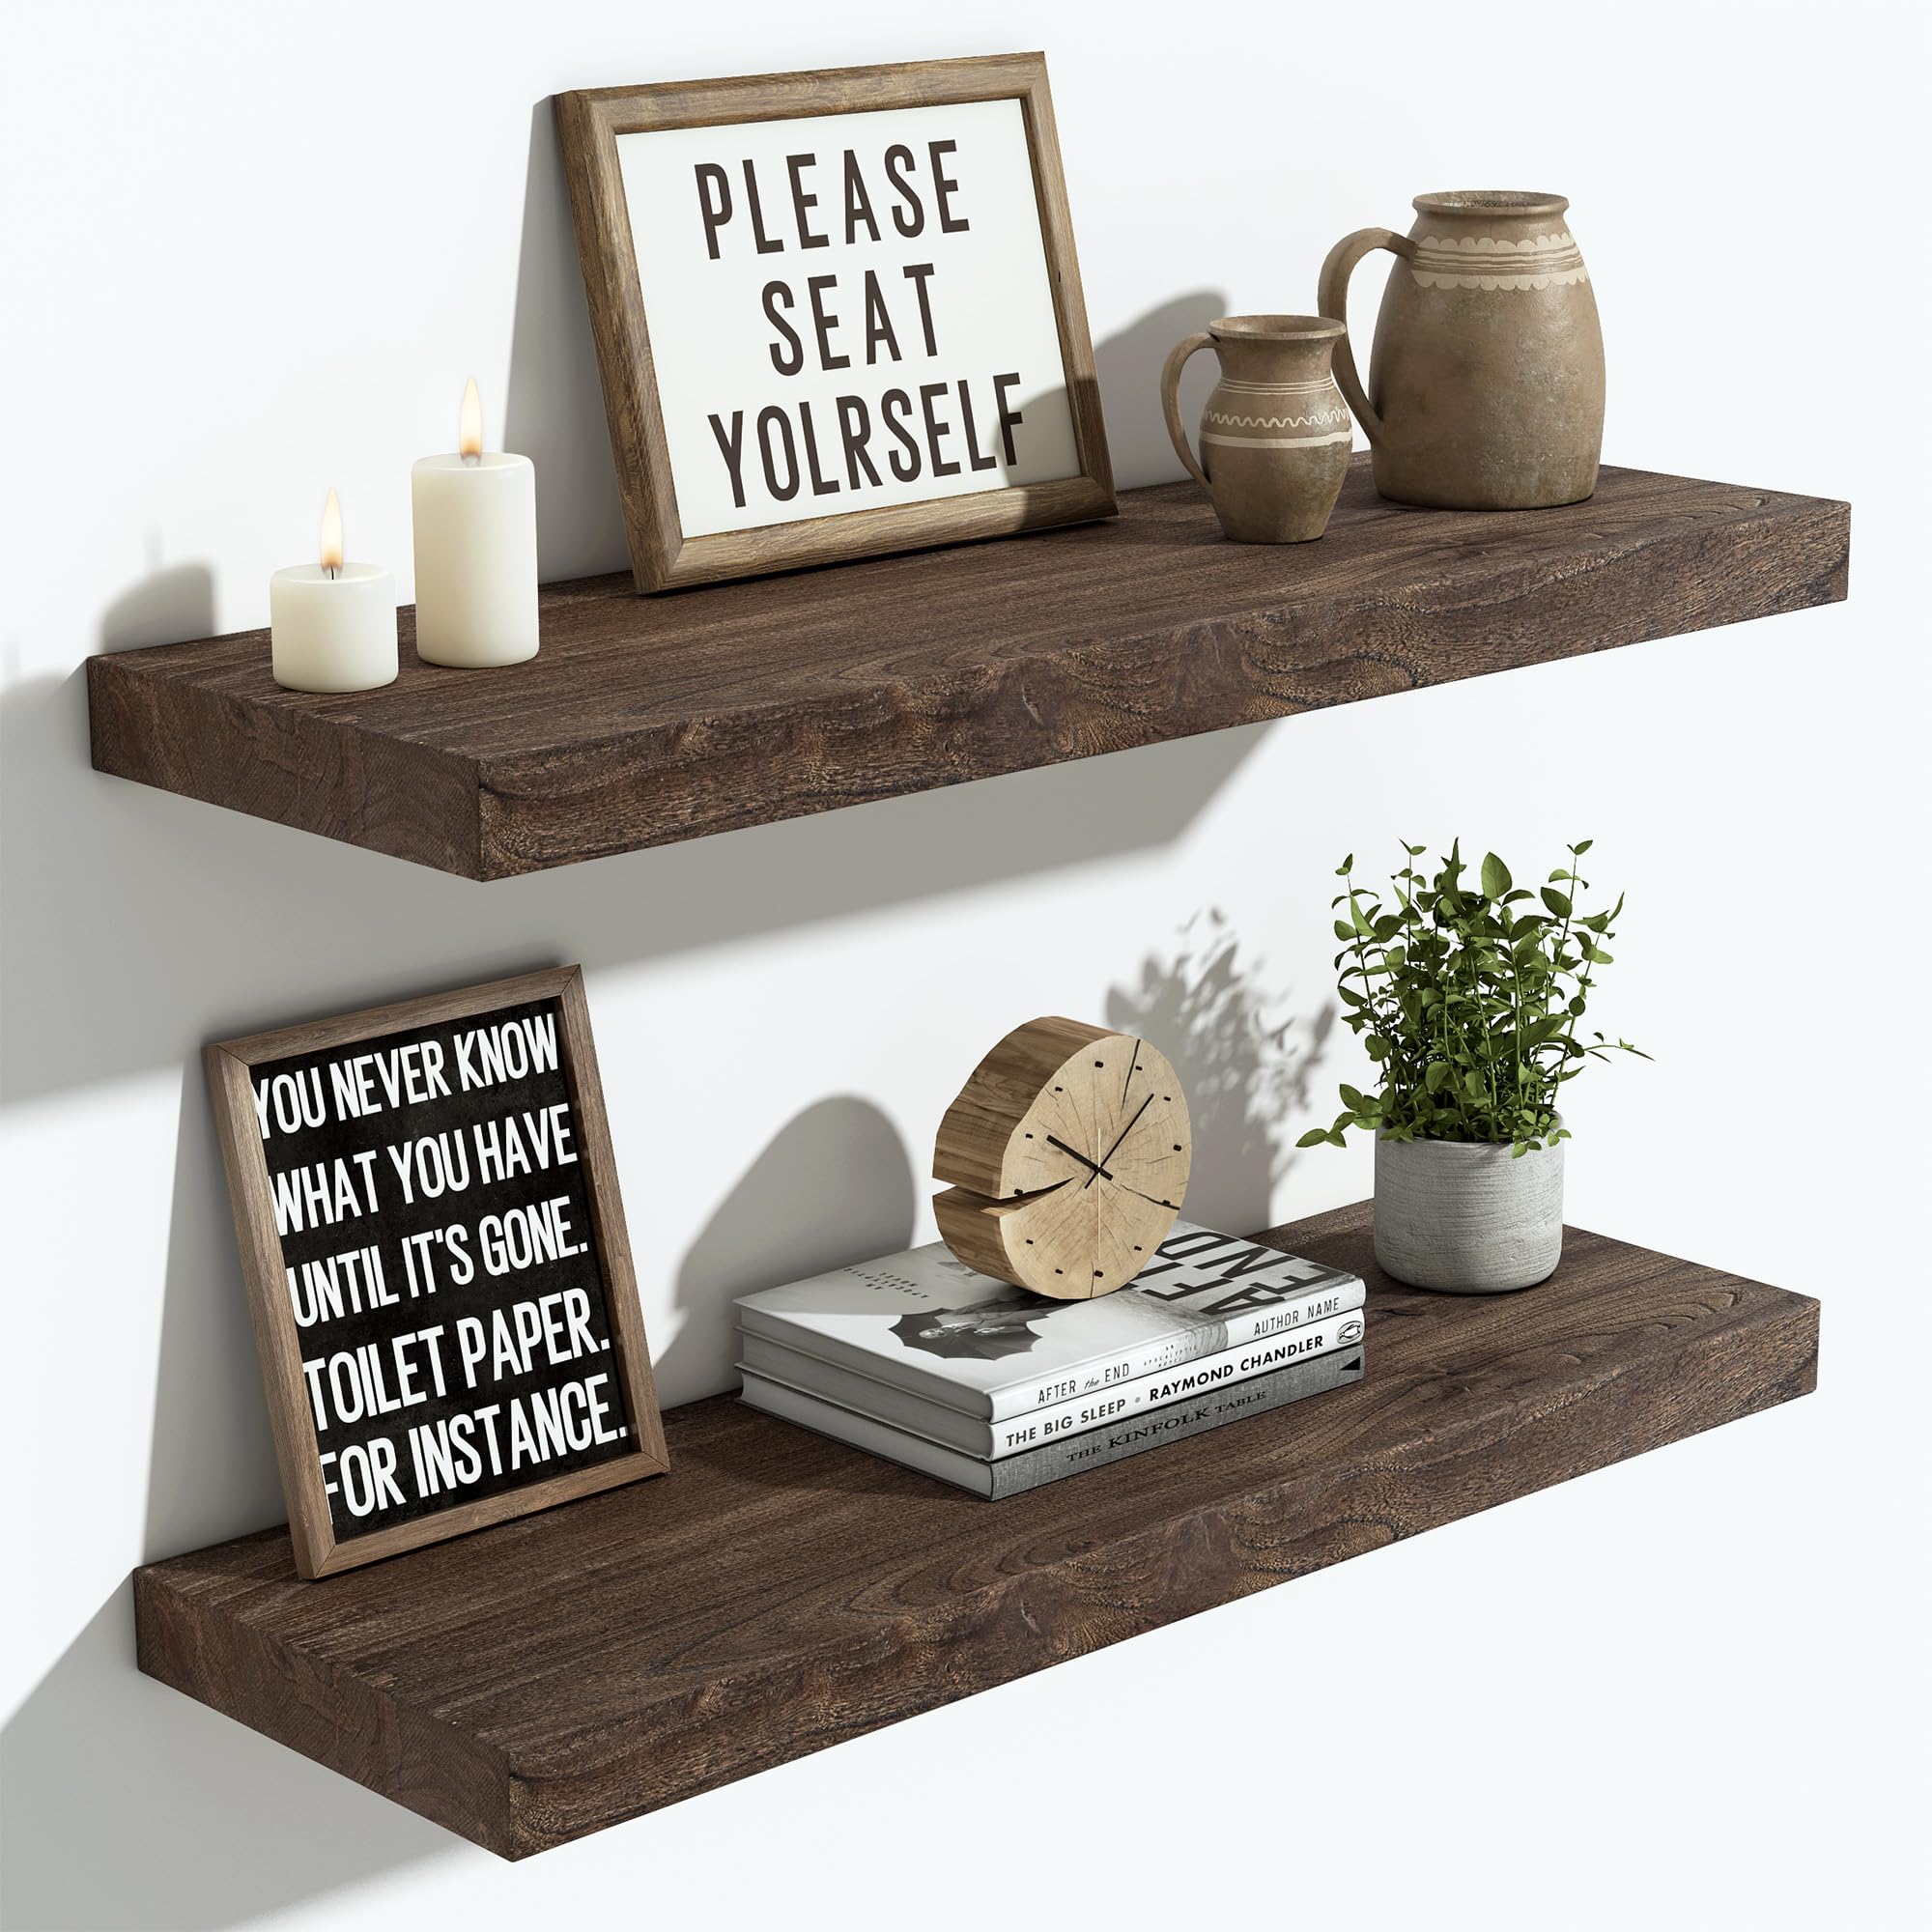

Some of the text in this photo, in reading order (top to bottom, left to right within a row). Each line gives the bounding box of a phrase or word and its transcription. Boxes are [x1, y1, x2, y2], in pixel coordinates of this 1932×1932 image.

[694, 139, 970, 260] PLEASE
[761, 263, 938, 377] SEAT
[708, 372, 1023, 508] YOLRSELF
[251, 1013, 558, 1140] YOU NEVER KNOW
[268, 1102, 578, 1236] WHAT YOU HAVE
[286, 1195, 588, 1327] UNTIL IT'S GONE.
[1253, 1297, 1340, 1336] AUTHOR NAME
[302, 1288, 611, 1432] TOILET PAPER.
[1006, 1335, 1323, 1447] THE BIG SLEEP RAYMOND CHANDLER
[1037, 1363, 1130, 1405] AFTER the END
[319, 1373, 627, 1525] FOR INSTANCE.
[1065, 1390, 1267, 1463] THE KINFOLK TABLE
